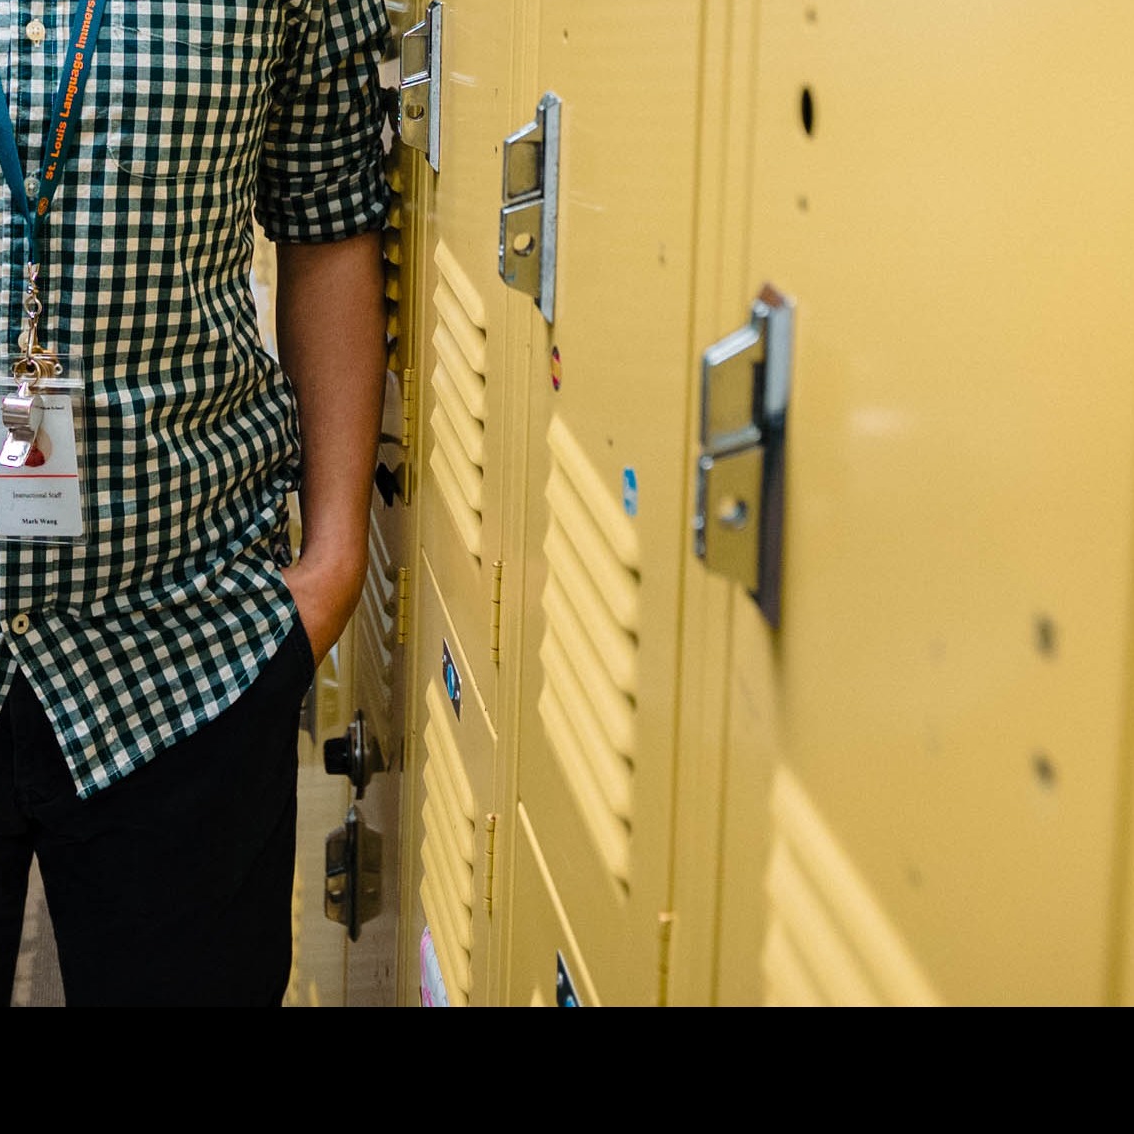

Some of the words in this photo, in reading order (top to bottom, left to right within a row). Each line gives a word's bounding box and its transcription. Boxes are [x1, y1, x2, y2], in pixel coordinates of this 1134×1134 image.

[59, 53, 83, 118] Language
[50, 121, 66, 157] Louis
[45, 162, 56, 180] St.
